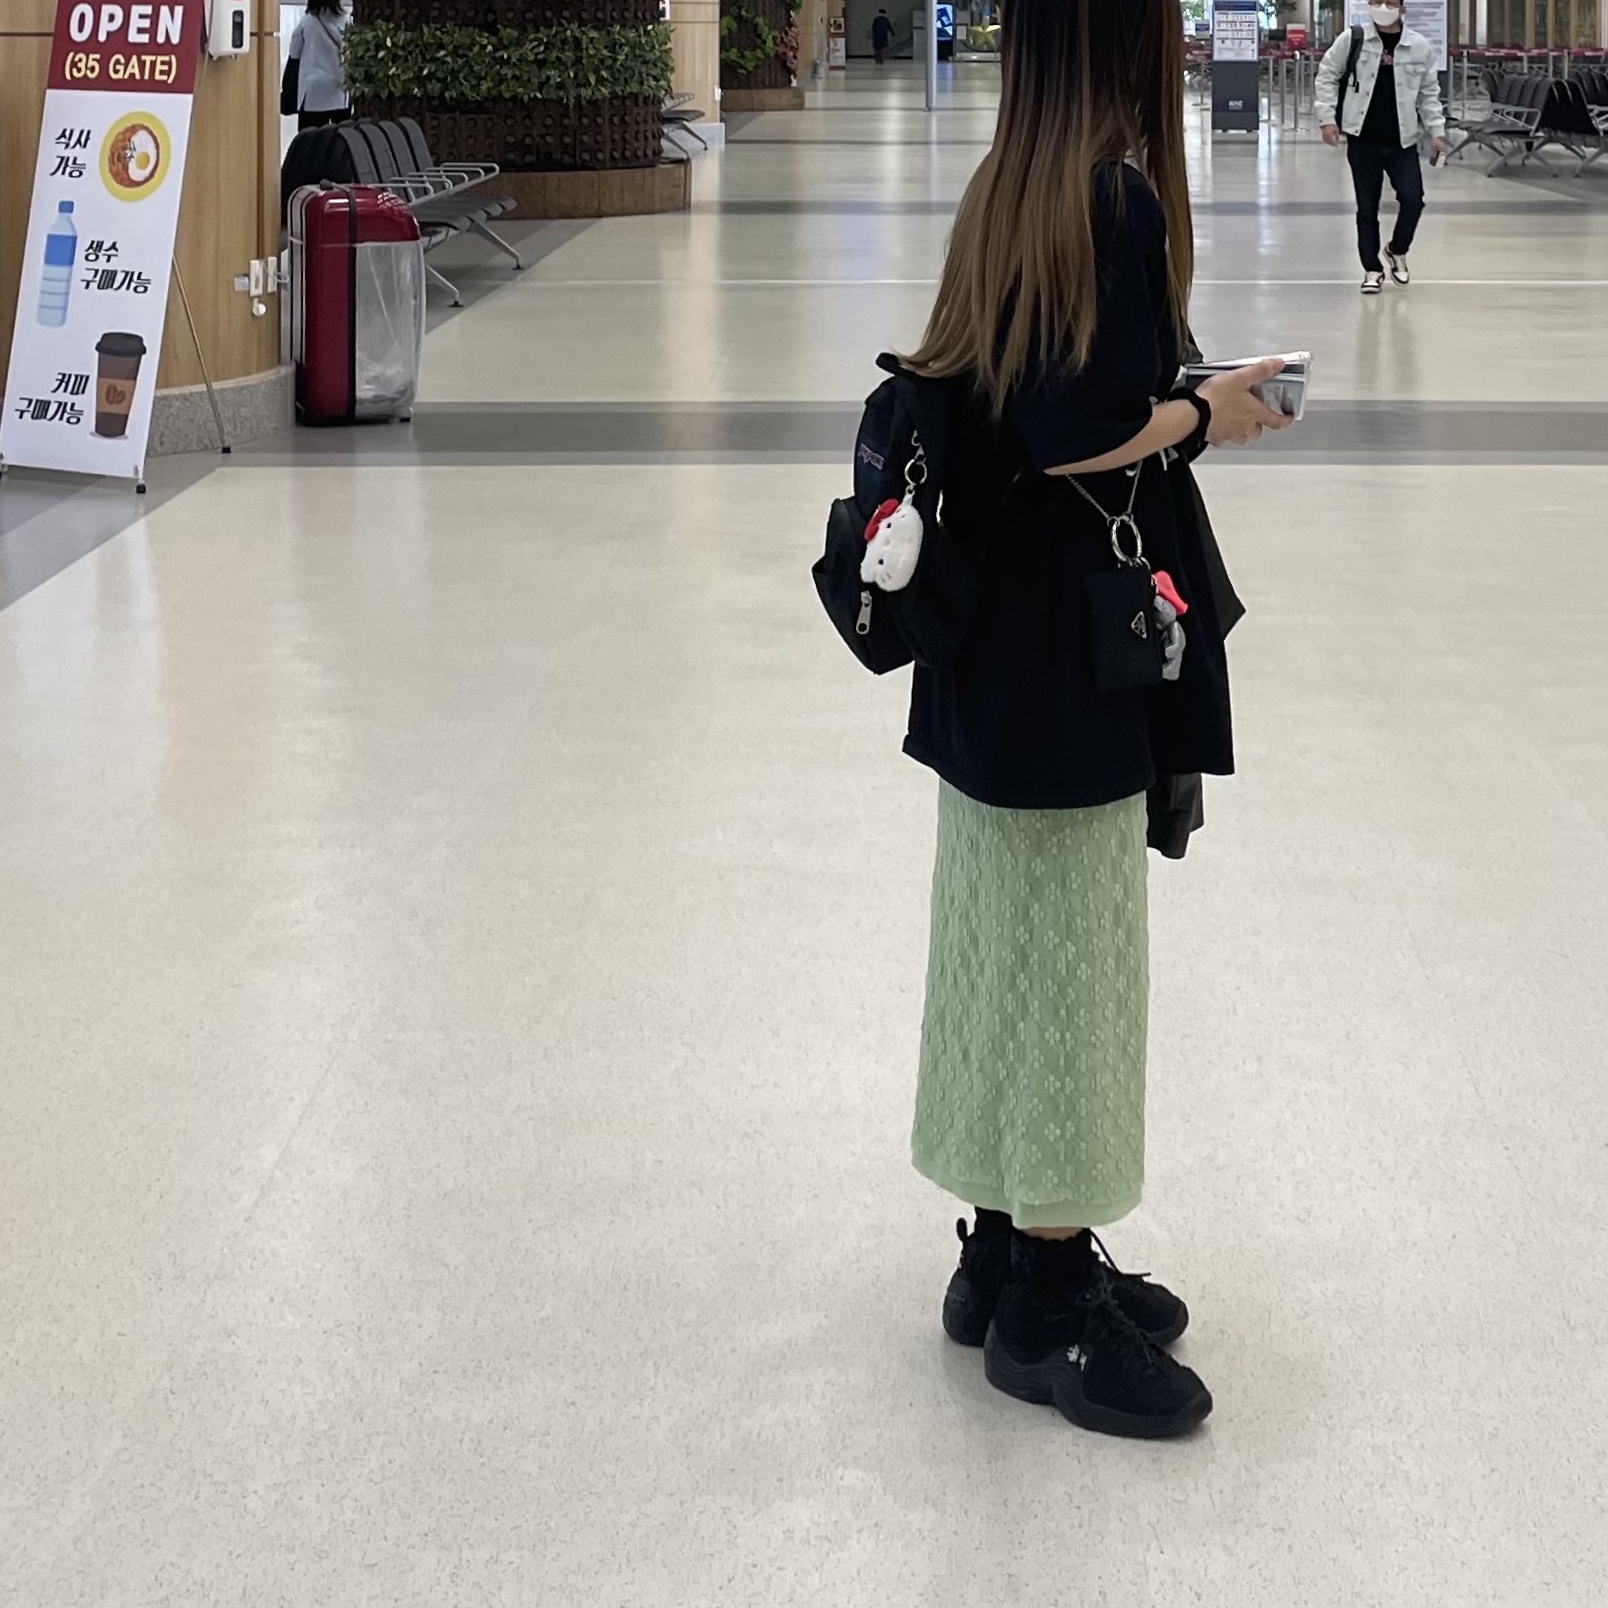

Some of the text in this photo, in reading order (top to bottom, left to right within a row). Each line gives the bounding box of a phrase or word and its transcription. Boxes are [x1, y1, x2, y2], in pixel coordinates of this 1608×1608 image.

[69, 3, 183, 45] OPEN
[64, 51, 177, 84] (35 GATE)
[55, 128, 91, 149] 식사
[49, 155, 87, 178] 가능
[84, 239, 119, 263] 생수
[80, 267, 151, 293] 구매가능
[51, 372, 90, 395] 커피
[14, 397, 84, 424] 구매가능
